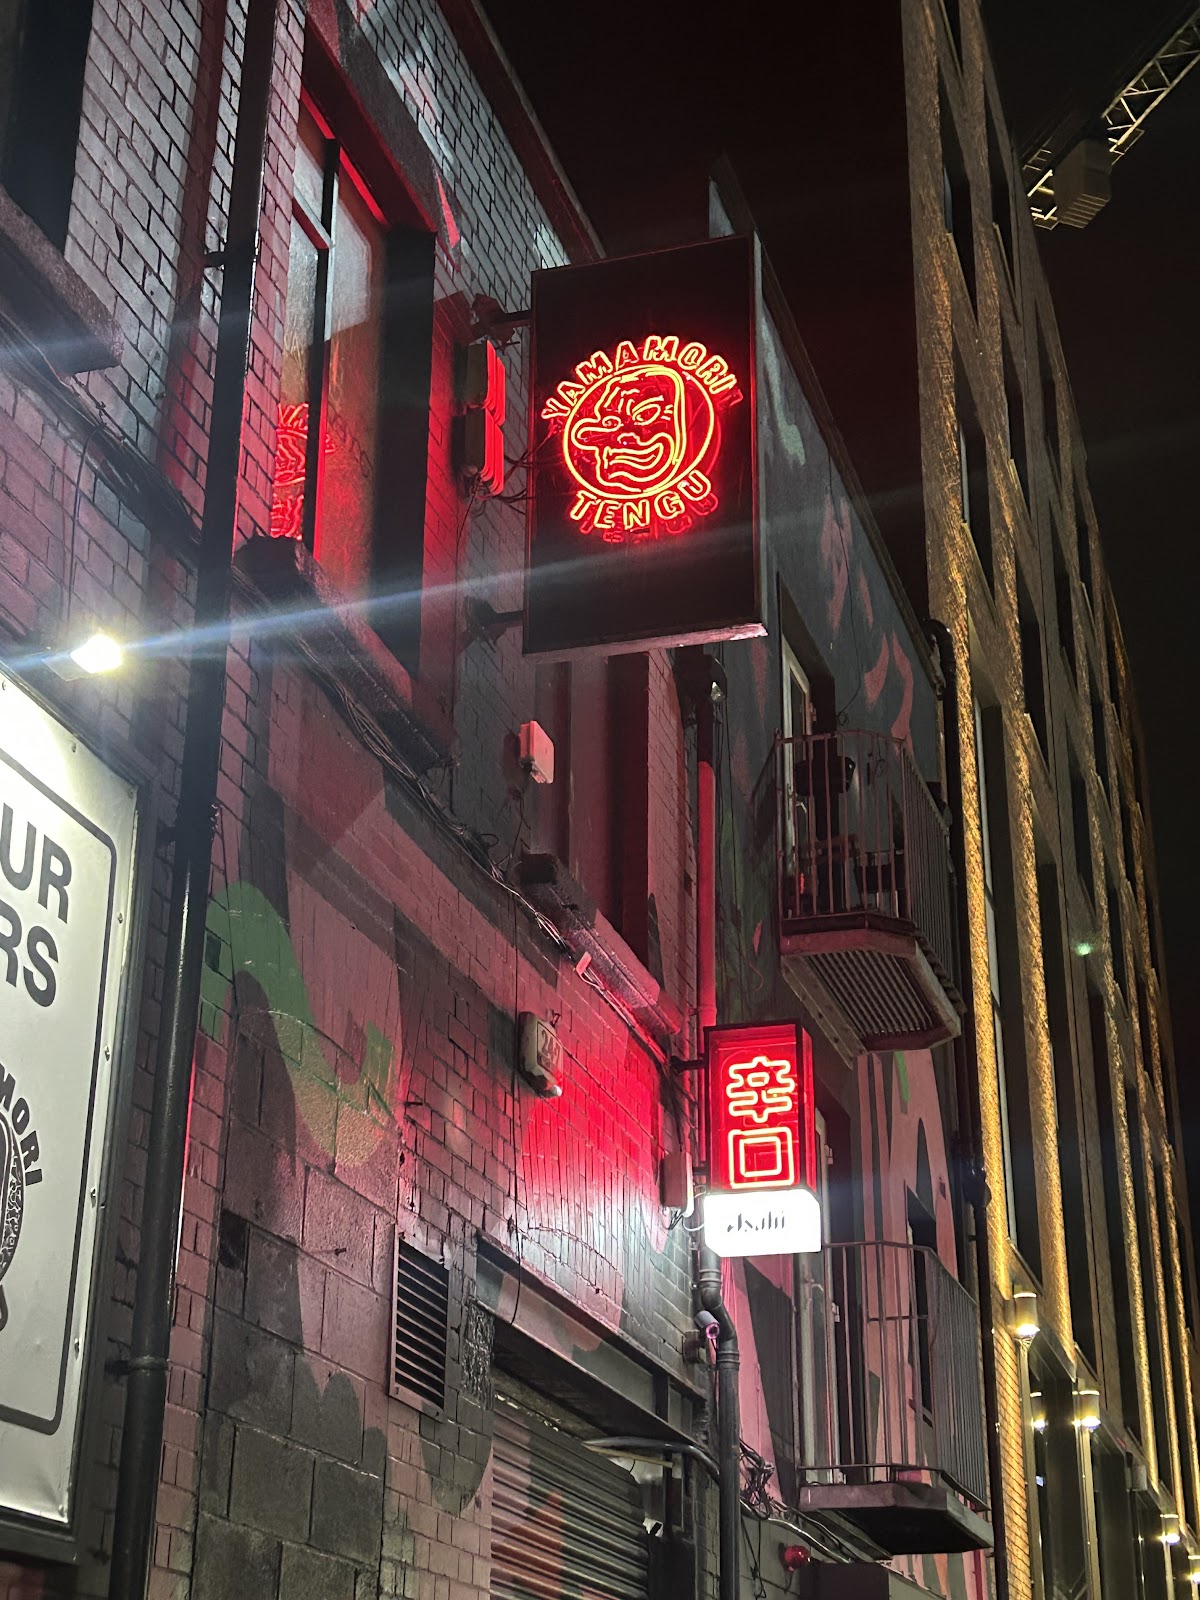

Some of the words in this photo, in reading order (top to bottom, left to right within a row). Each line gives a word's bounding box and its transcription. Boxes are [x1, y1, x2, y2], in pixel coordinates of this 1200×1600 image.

[541, 335, 738, 420] YAMAMORI
[570, 469, 712, 530] TENGU
[0, 802, 72, 925] UR
